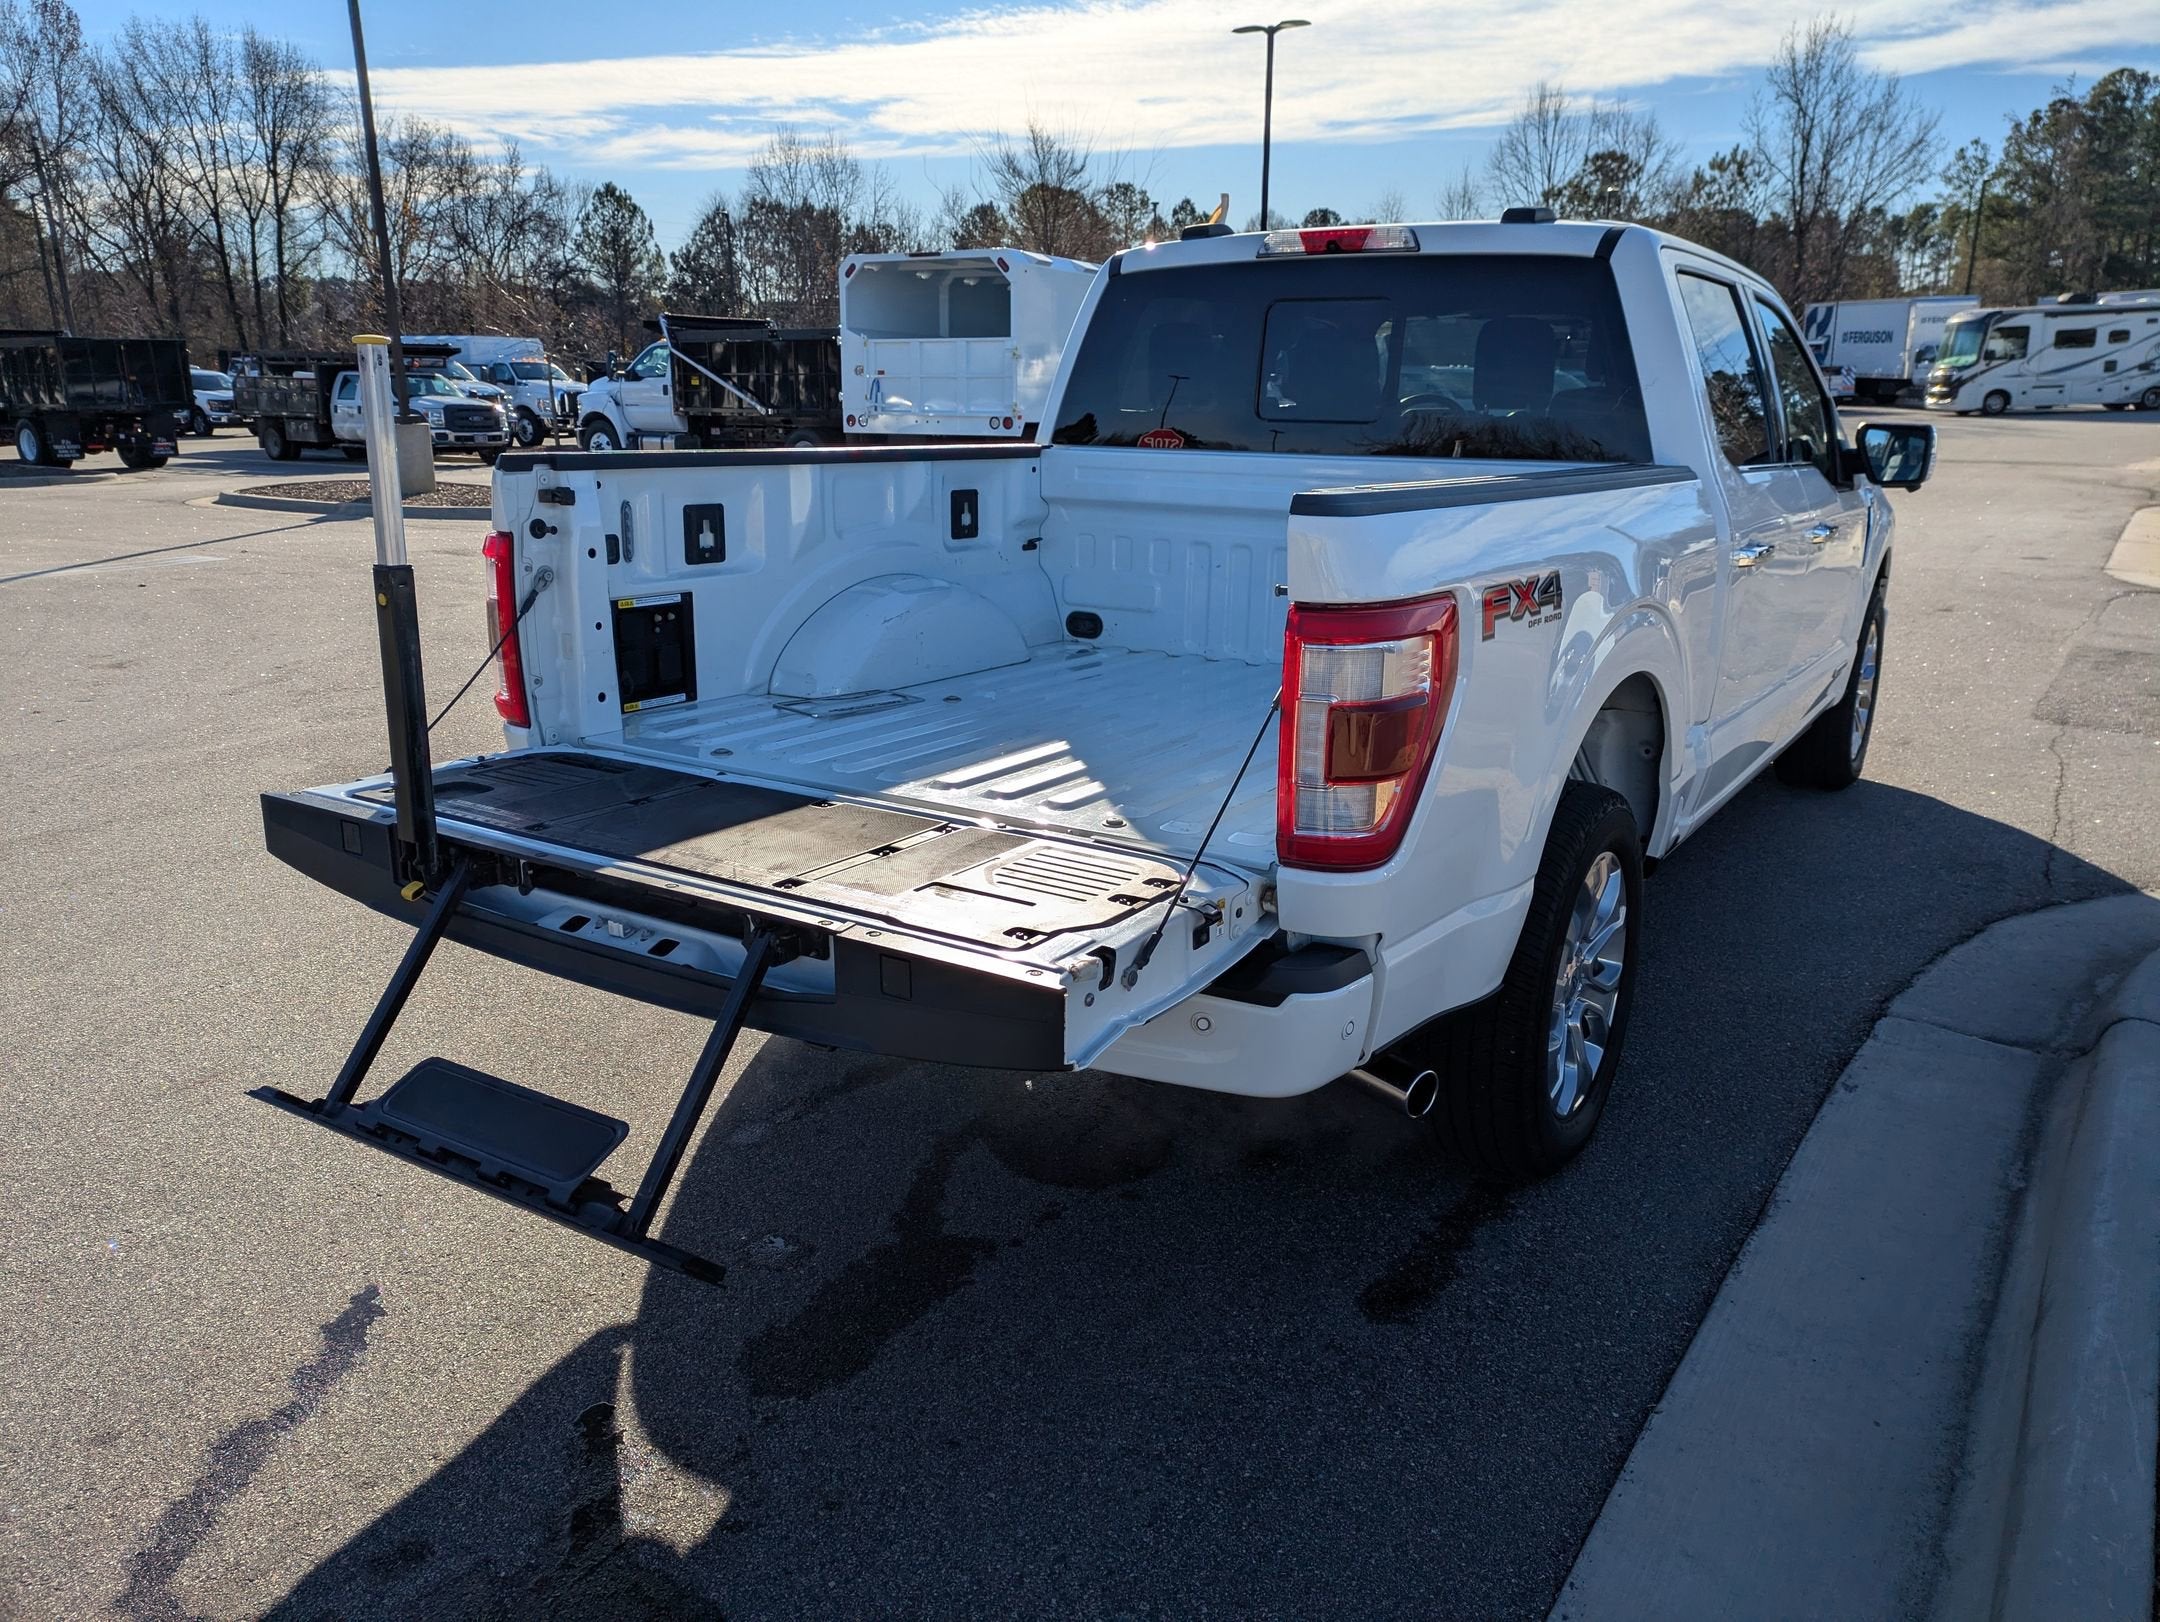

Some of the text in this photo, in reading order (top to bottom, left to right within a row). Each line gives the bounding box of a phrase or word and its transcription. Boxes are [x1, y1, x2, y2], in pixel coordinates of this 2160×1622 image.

[1849, 330, 1894, 344] FERGUSON
[1482, 569, 1562, 642] FX4
[1528, 612, 1563, 629] OFF ROAD
